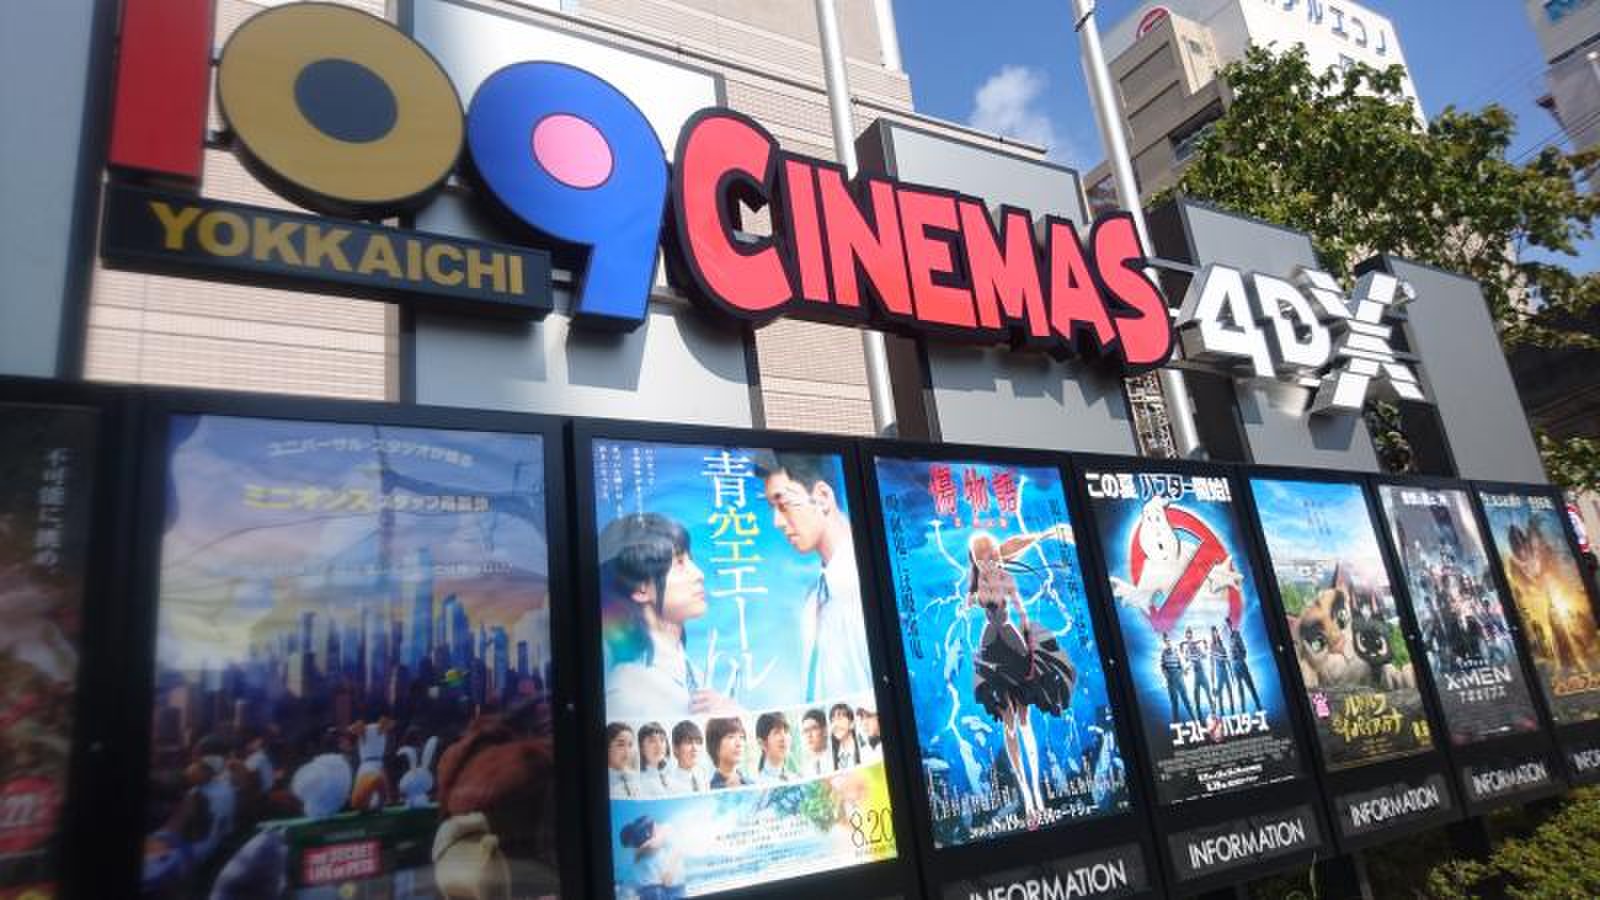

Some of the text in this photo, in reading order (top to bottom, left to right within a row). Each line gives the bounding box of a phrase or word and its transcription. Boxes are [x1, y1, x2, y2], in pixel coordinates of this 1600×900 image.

[107, 0, 1173, 367] 109 CINEMAS
[148, 201, 525, 295] YOKKAICHI
[1195, 262, 1425, 413] 4DX
[702, 451, 779, 696] 青空エール
[1350, 785, 1440, 827] INFORMATION
[1472, 760, 1548, 795] INFORMATION
[849, 807, 892, 848] 8.20
[1188, 818, 1306, 869] INFORMATION
